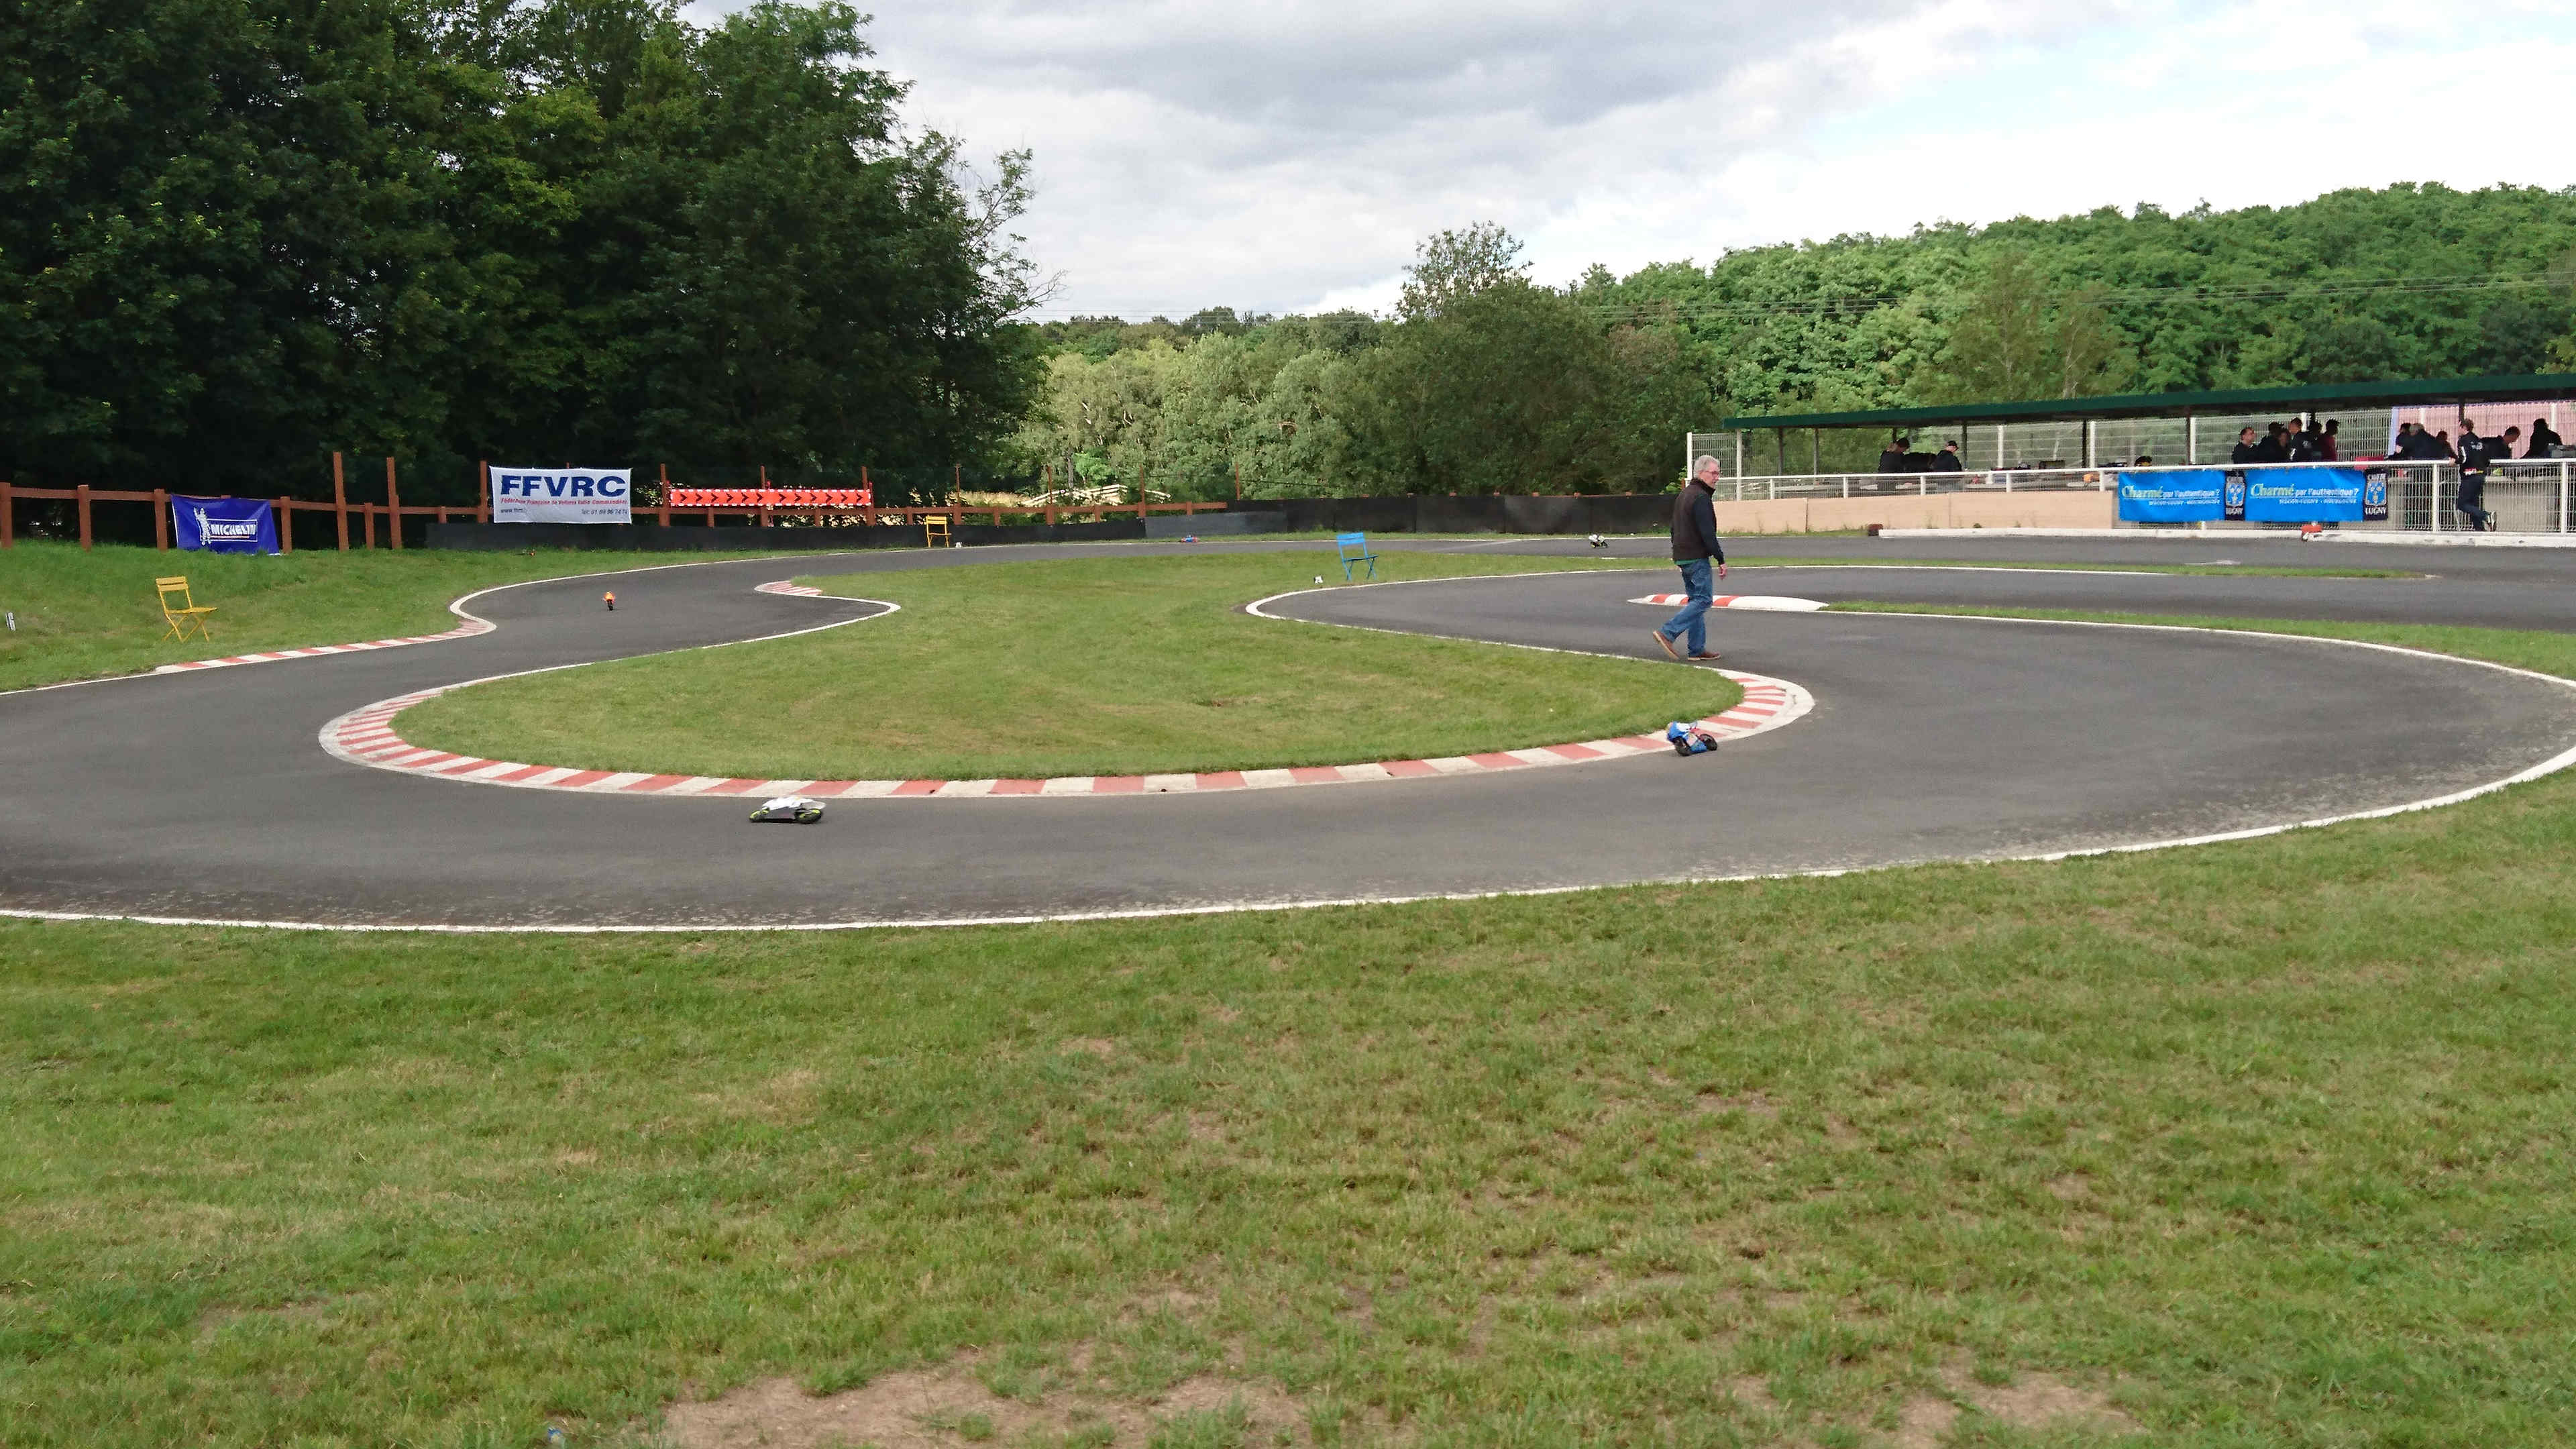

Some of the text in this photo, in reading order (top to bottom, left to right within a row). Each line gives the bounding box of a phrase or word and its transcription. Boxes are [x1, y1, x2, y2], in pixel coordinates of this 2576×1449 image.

[500, 475, 626, 497] FFVRC
[2122, 485, 2163, 498] Charmé
[2250, 484, 2295, 496] Charmé
[2365, 507, 2386, 515] LUGNY
[211, 524, 256, 535] MICHELIN
